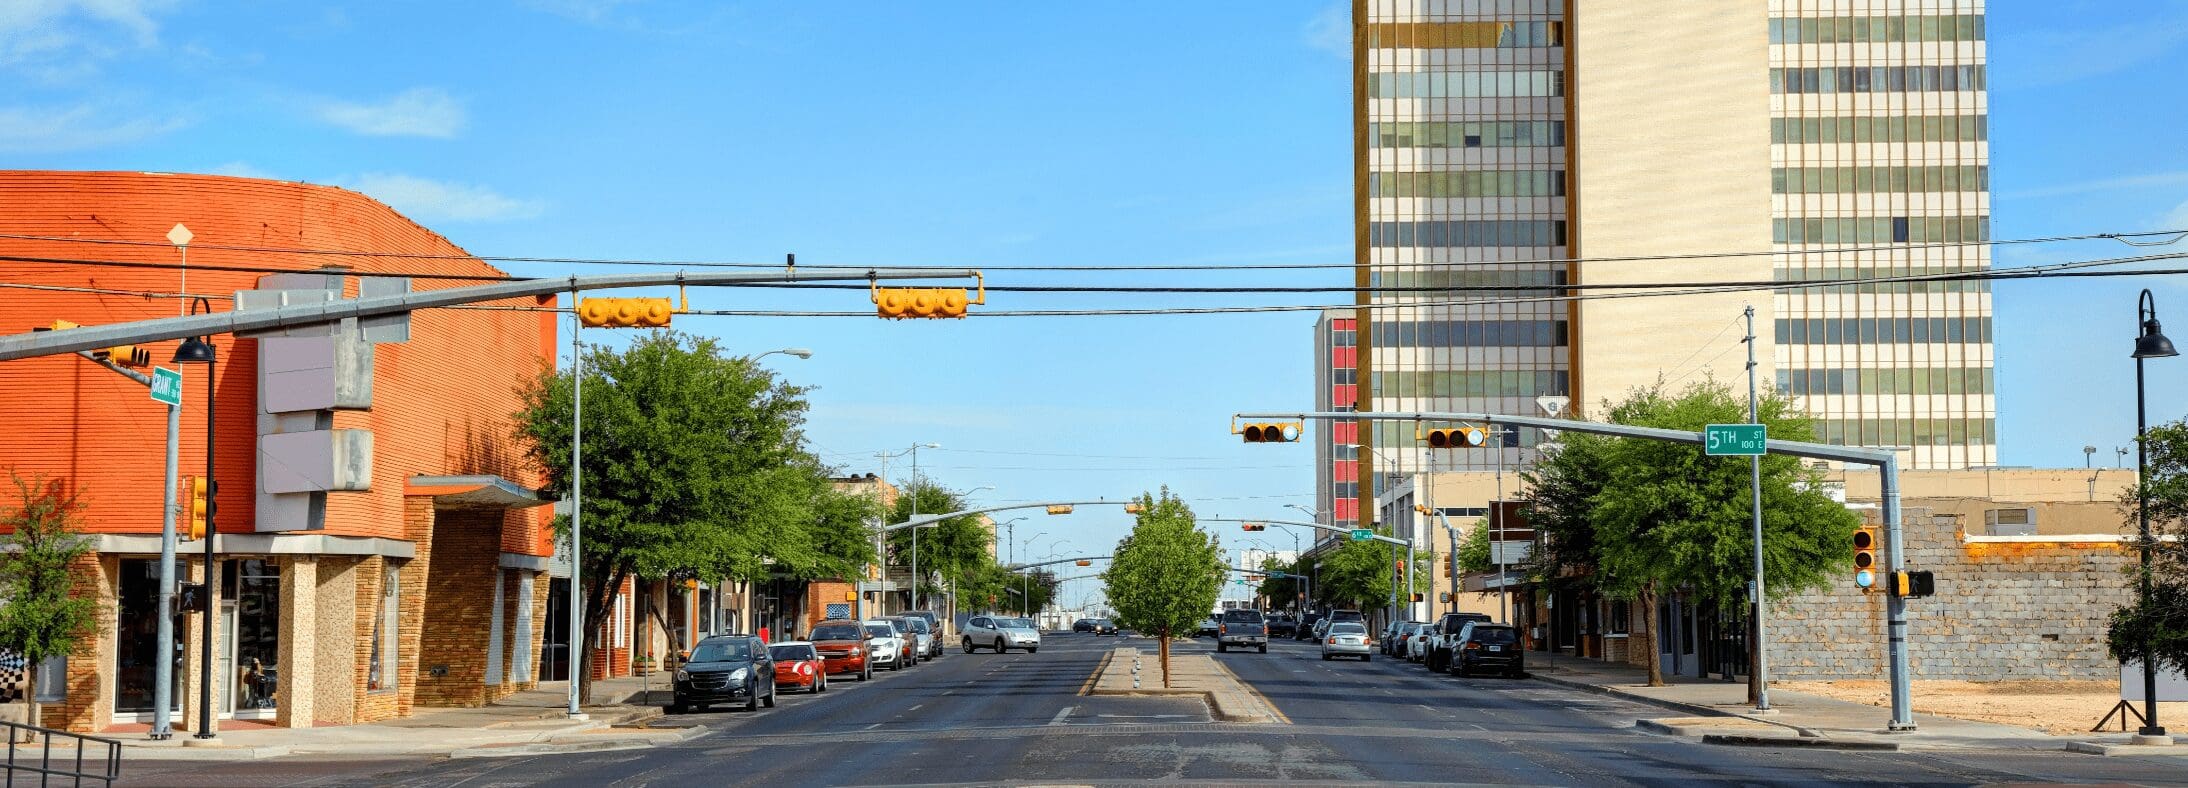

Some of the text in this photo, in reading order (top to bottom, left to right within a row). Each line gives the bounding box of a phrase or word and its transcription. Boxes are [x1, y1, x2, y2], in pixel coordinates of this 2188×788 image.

[152, 374, 172, 397] GRANT
[1709, 430, 1736, 449] 5TH
[1753, 431, 1762, 439] ST
